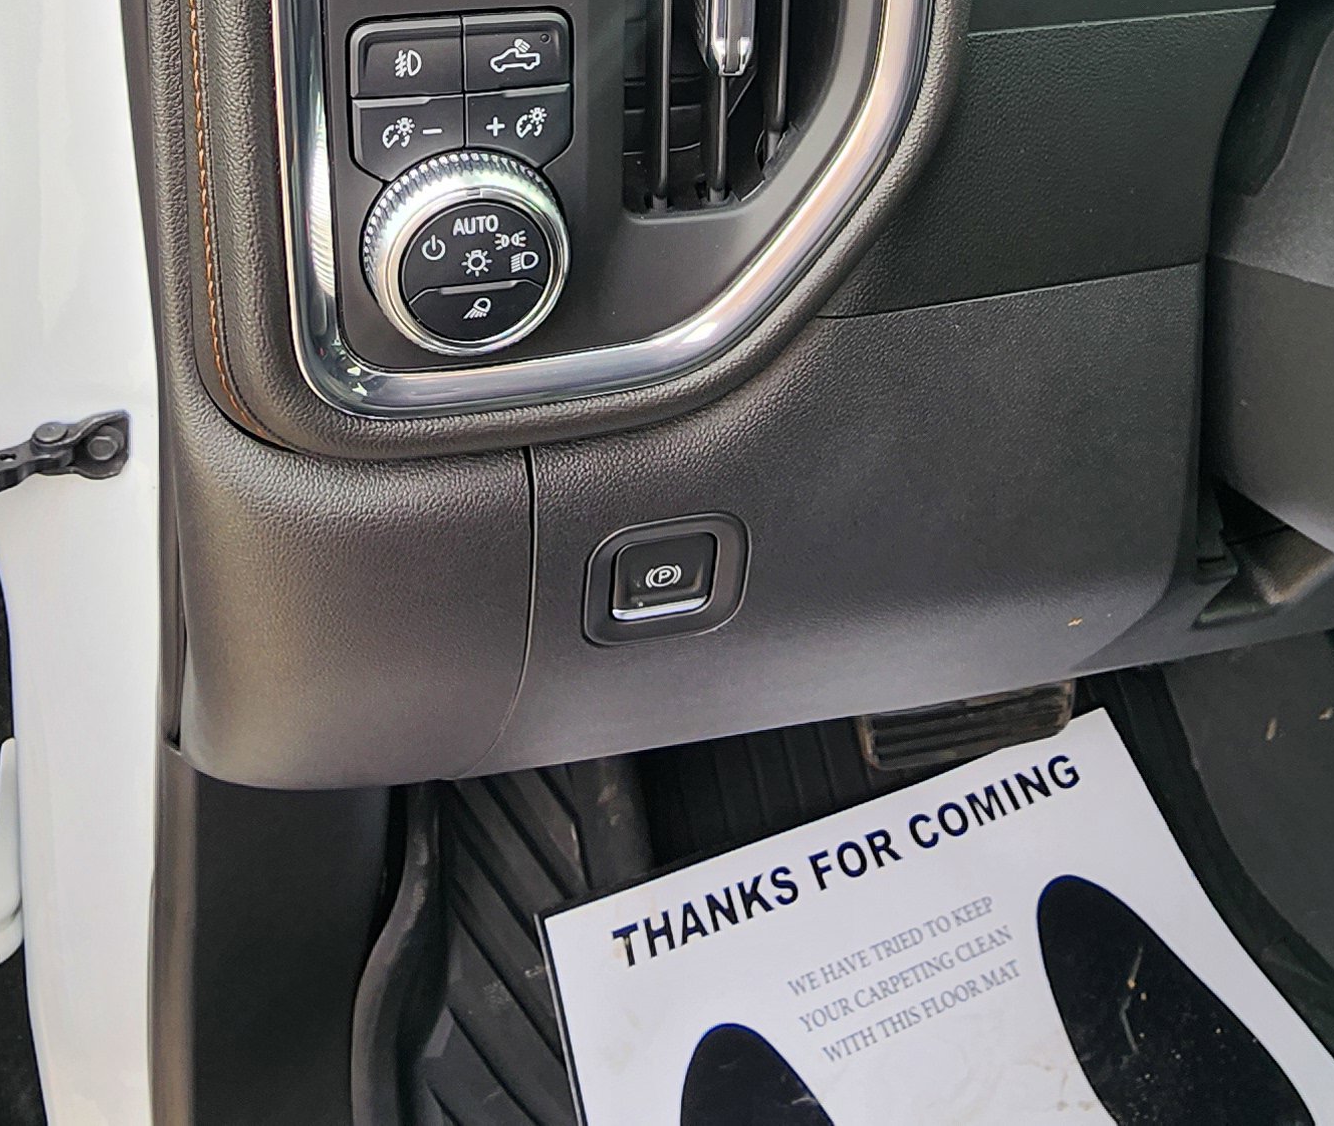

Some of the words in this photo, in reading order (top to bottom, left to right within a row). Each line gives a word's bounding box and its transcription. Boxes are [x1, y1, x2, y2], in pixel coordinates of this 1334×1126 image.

[453, 214, 499, 236] AUTO
[611, 866, 799, 968] THANKS
[808, 828, 902, 891] FOR
[908, 754, 1082, 849] COMING
[787, 970, 821, 997] WE
[819, 949, 872, 984] HAVE
[869, 927, 924, 962] TRIED
[923, 915, 952, 938] TO
[951, 895, 993, 927] KEEP
[799, 996, 855, 1033] YOUR
[853, 951, 956, 1009] CARPETING
[954, 925, 1014, 963] CLEAN
[822, 1026, 879, 1063] WITH
[876, 1005, 922, 1038] THIS
[920, 978, 983, 1019] FLOOR
[981, 958, 1021, 992] MAT
